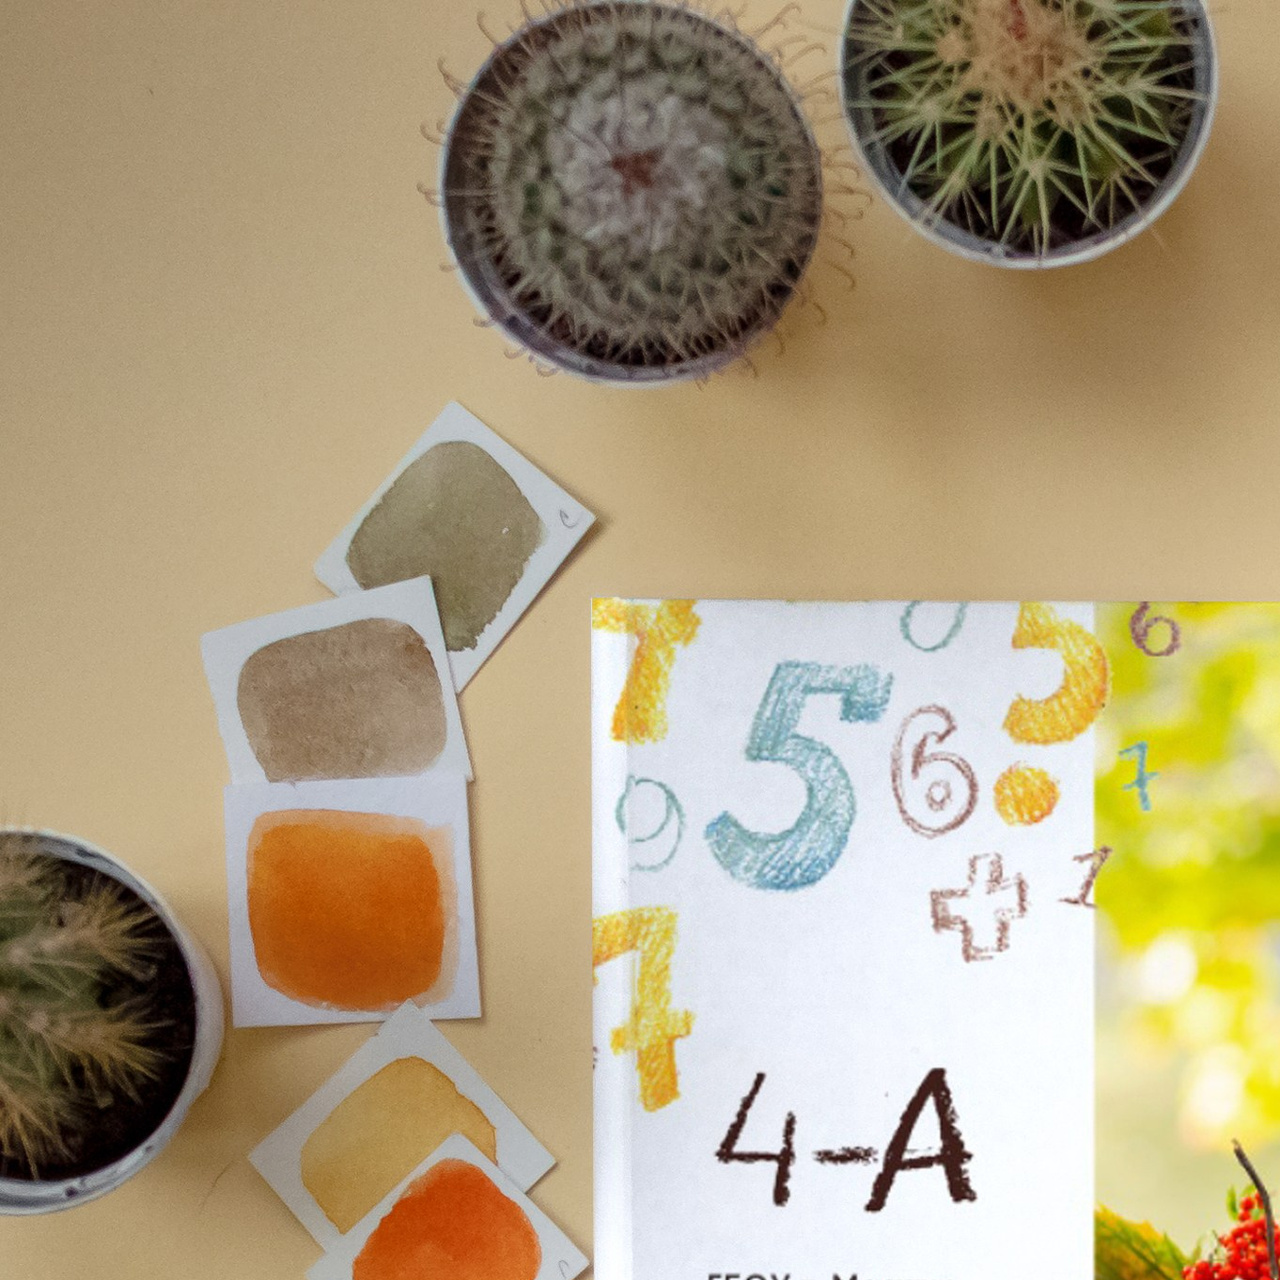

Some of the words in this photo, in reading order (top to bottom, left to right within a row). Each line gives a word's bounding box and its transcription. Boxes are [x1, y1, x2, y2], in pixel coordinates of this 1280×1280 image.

[704, 659, 893, 892] 5
[890, 704, 979, 839] 6
[1118, 741, 1158, 811] 7
[1057, 846, 1112, 908] 1
[716, 1068, 978, 1212] 4-А
